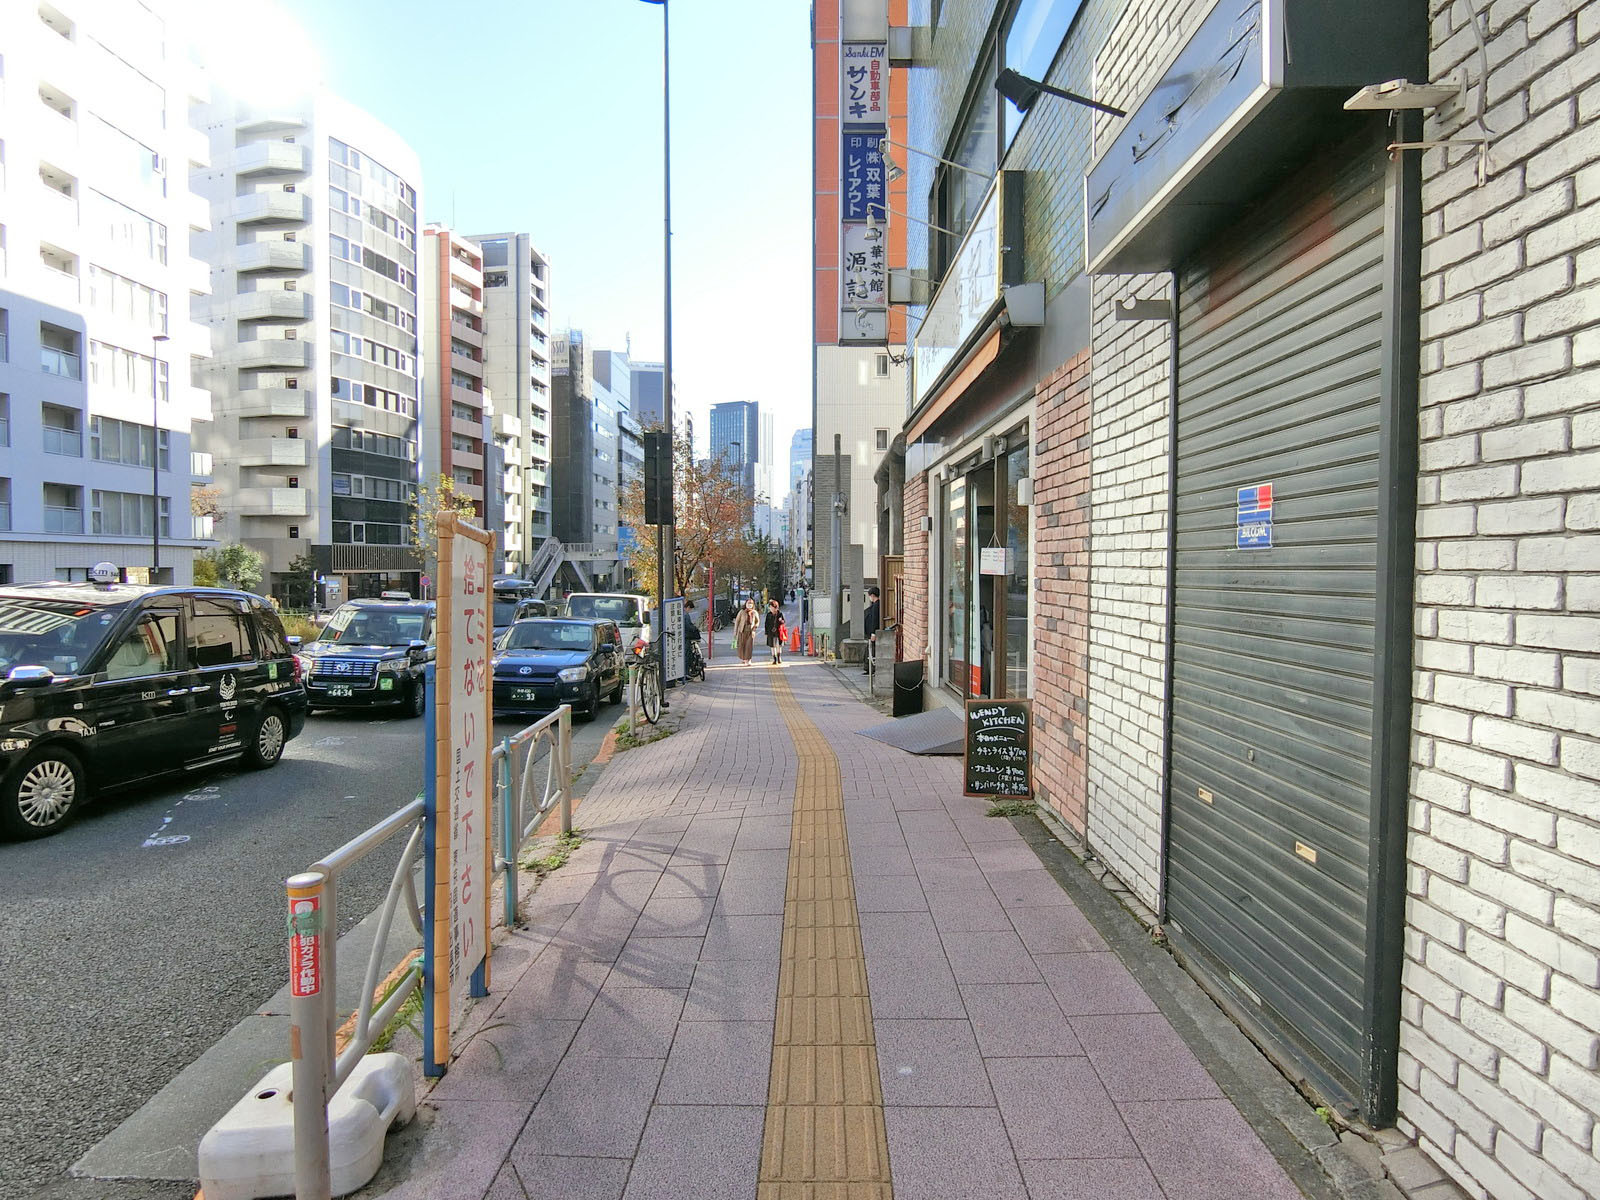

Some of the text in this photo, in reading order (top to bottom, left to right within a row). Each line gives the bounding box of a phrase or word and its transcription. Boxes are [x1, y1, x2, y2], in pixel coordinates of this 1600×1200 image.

[870, 46, 885, 58] EM
[847, 66, 868, 119] サンキ
[870, 59, 881, 112] 自動車部品
[848, 154, 862, 217] レイアウト
[141, 690, 156, 701] km
[970, 706, 1008, 720] WENDY
[982, 712, 1025, 727] KITCHEN
[79, 726, 97, 737] TAXI
[976, 733, 1016, 743] 本日のメニュー
[462, 552, 475, 958] 捨てないで下さい
[300, 933, 316, 994] 犯カメラ作動中
